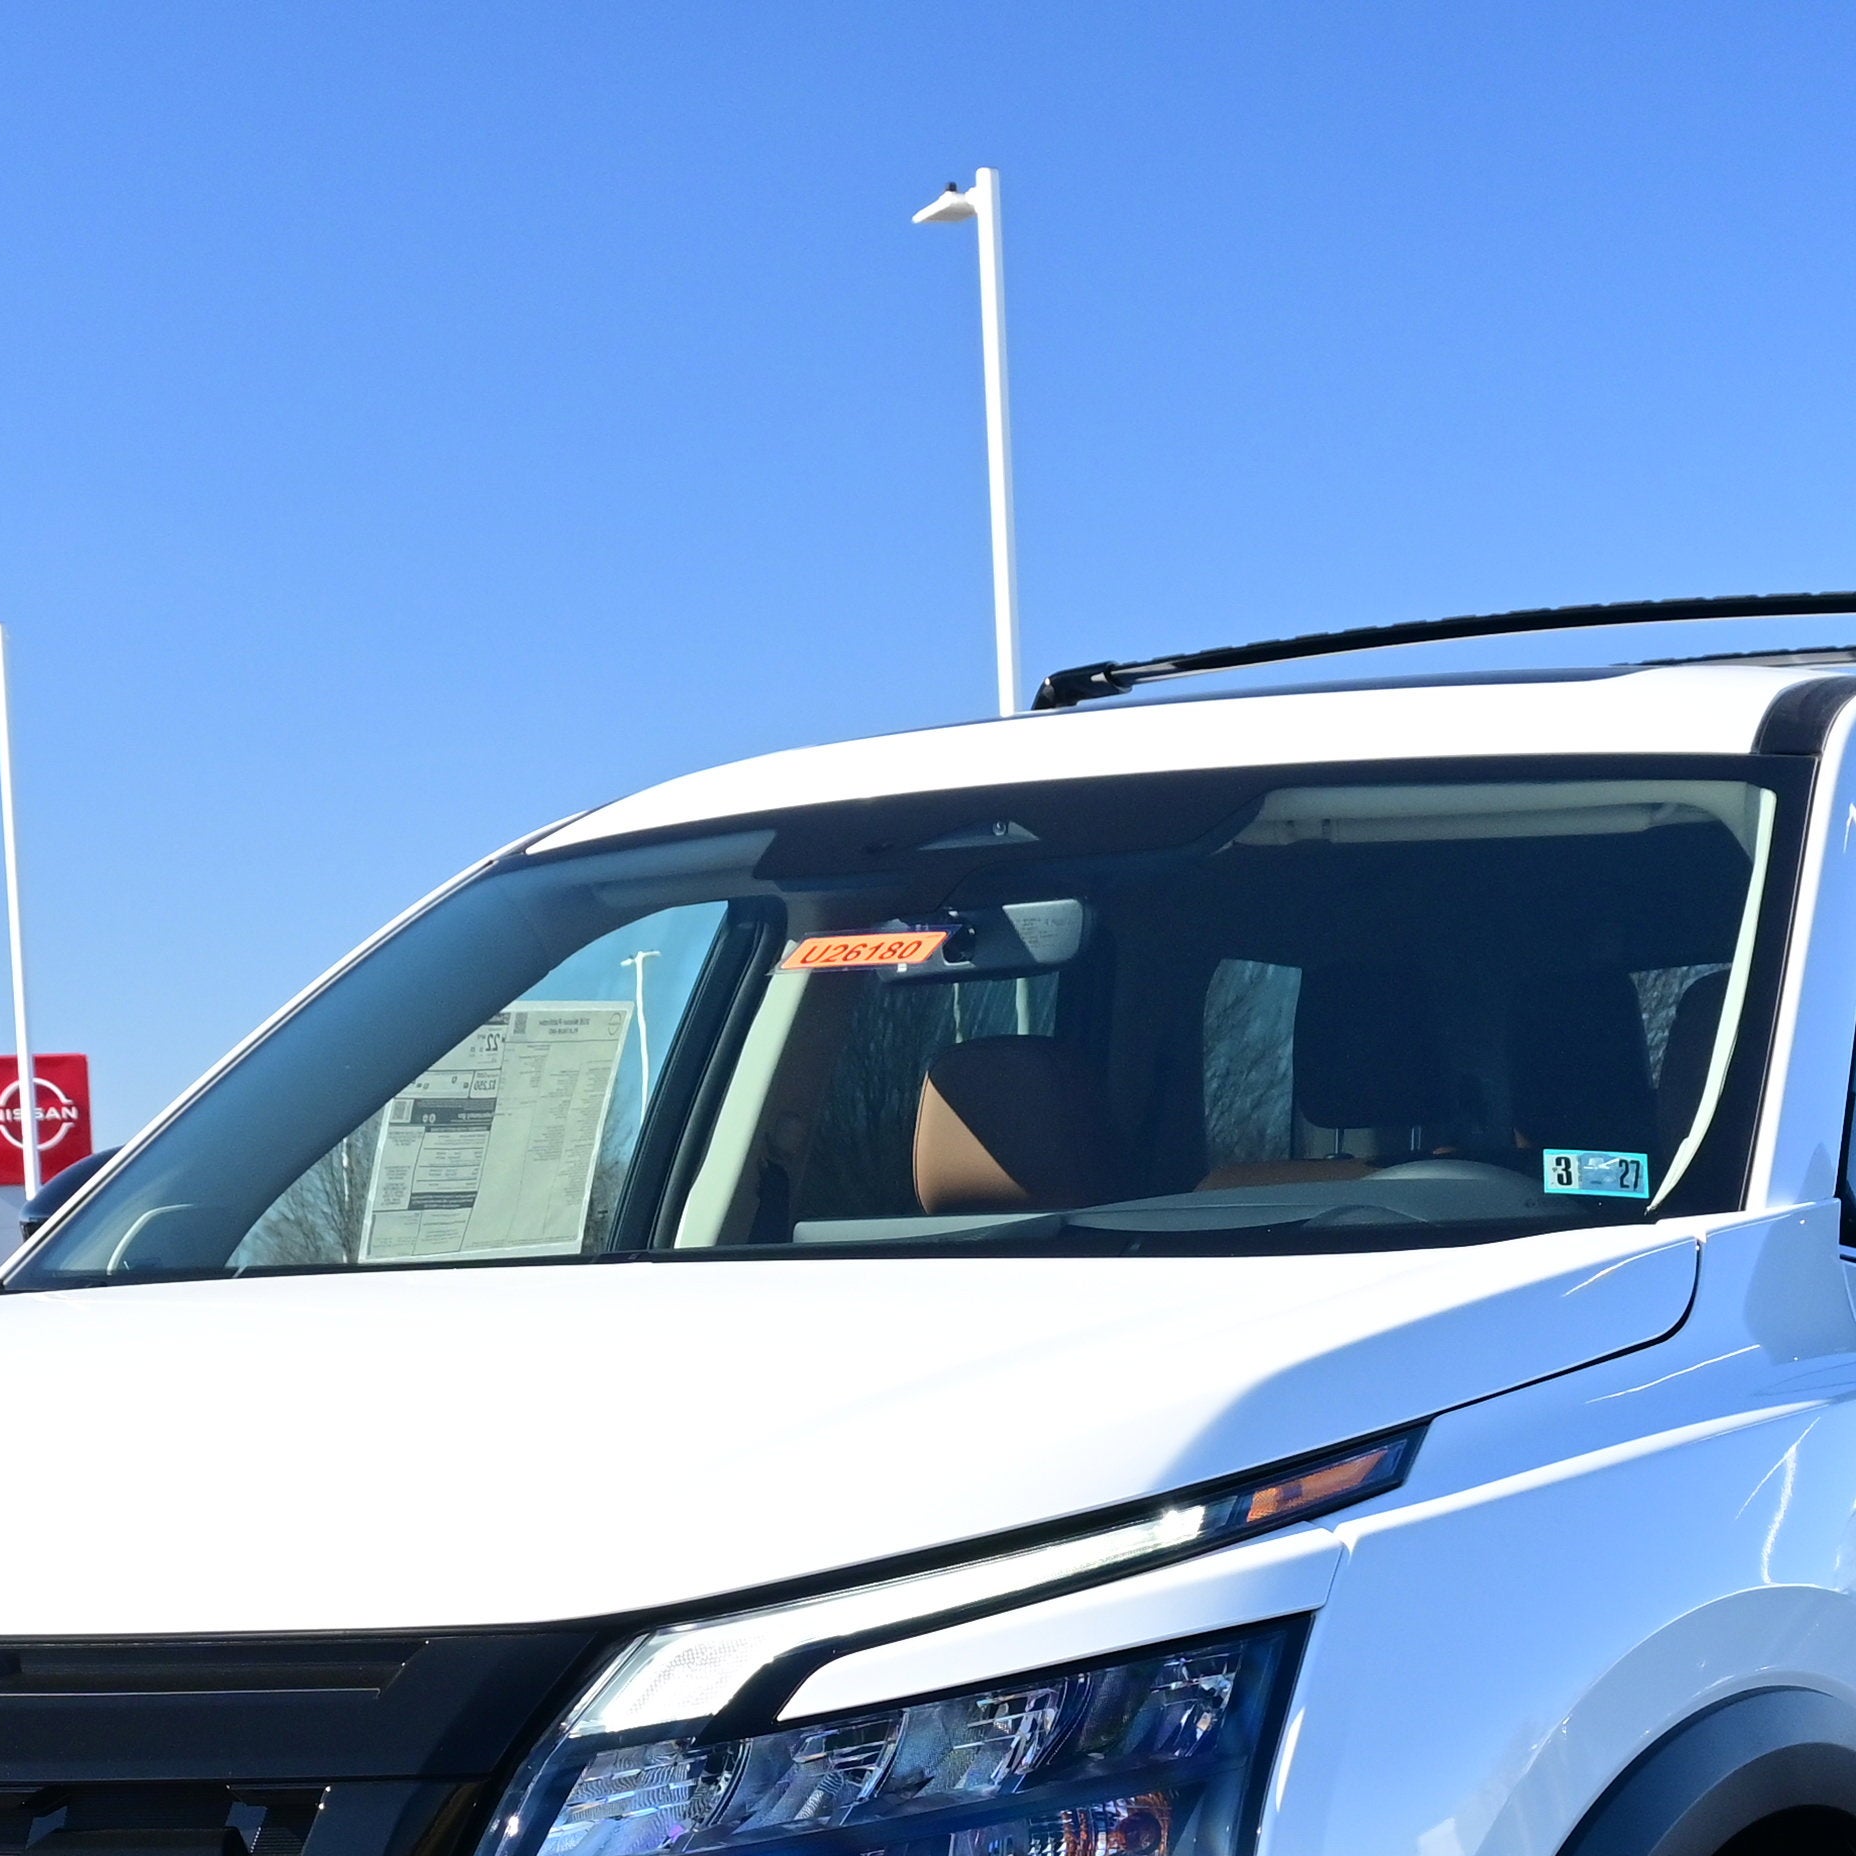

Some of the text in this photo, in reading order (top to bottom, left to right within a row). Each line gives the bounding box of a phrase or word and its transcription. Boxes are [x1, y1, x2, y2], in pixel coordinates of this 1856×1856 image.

[800, 940, 923, 964] U26180
[1555, 1156, 1641, 1192] 3 27
